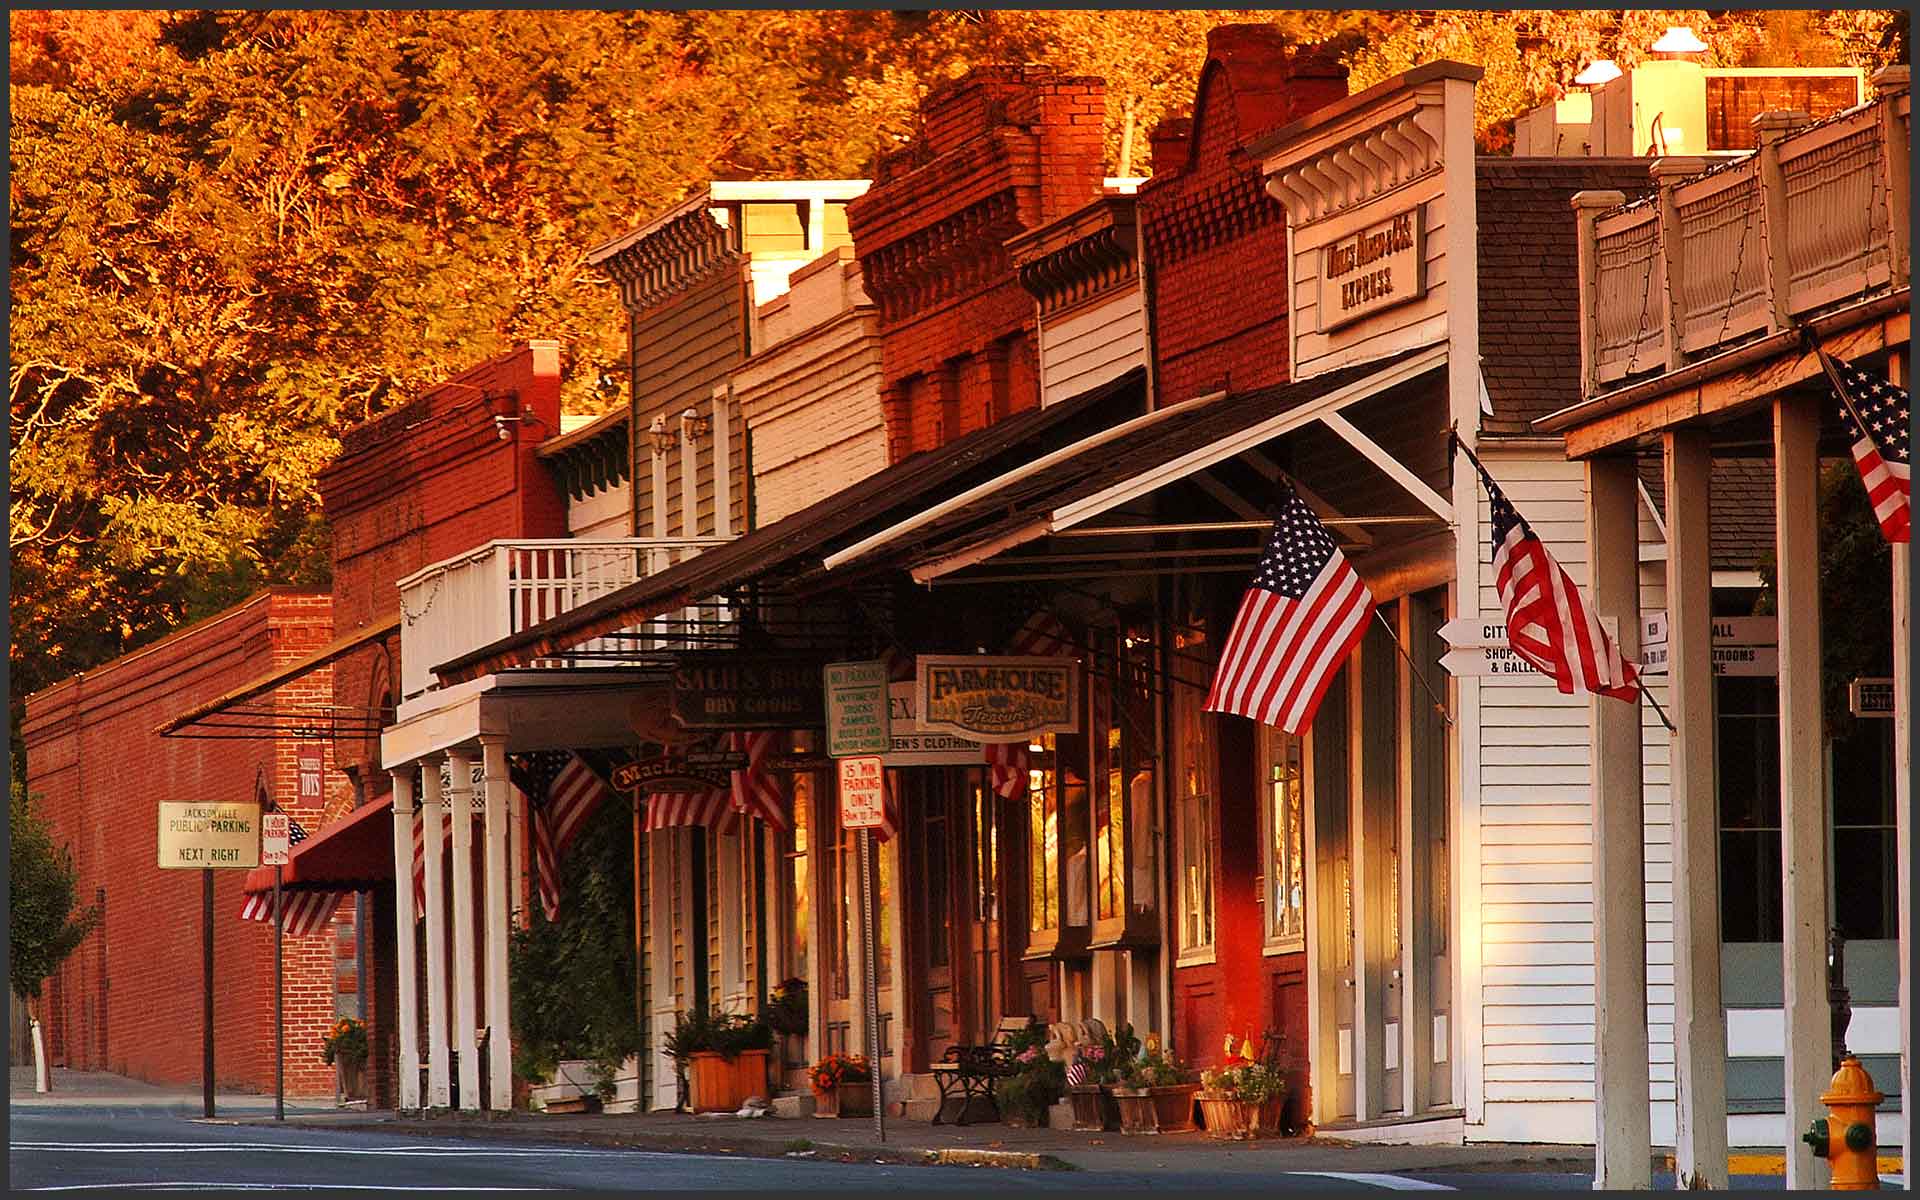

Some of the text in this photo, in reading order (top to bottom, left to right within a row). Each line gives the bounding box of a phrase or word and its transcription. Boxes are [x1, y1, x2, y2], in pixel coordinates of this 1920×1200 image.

[1491, 662, 1499, 673] &
[934, 668, 1066, 700] FARMHOUSE
[924, 737, 981, 750] CLOTHING
[860, 762, 877, 776] MIN
[301, 773, 320, 797] TOYS
[843, 776, 881, 791] PARKING
[851, 793, 874, 808] ONLY
[183, 808, 238, 820] JACKSONVILLE
[170, 820, 251, 833] PUBLIC PARKING
[178, 847, 241, 861] NEXT RIGHT
